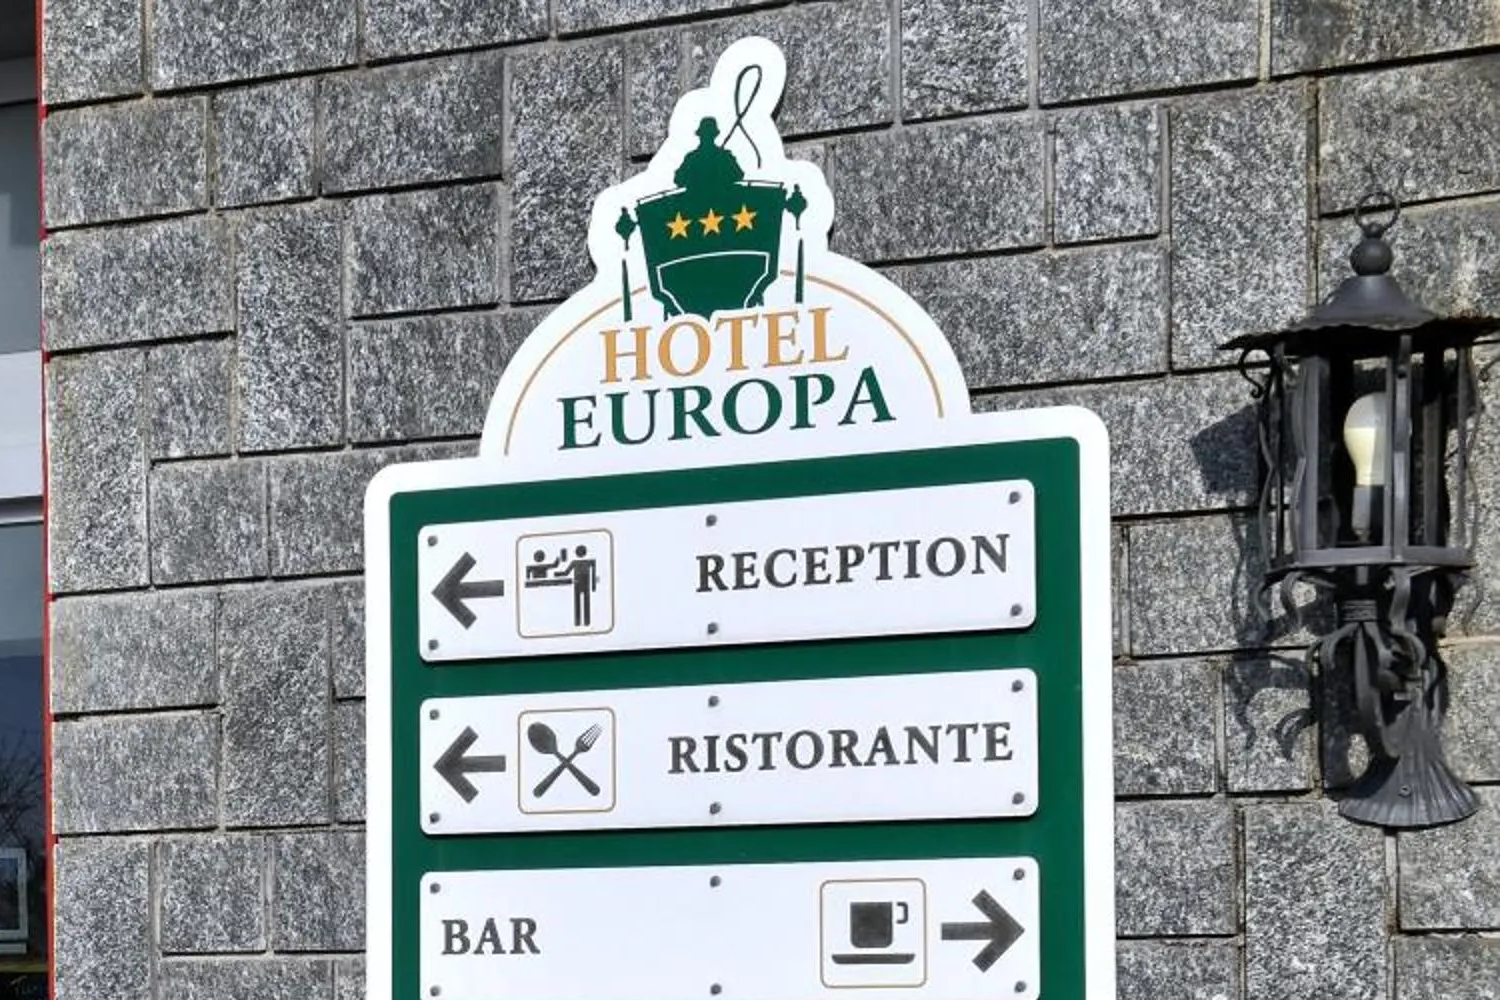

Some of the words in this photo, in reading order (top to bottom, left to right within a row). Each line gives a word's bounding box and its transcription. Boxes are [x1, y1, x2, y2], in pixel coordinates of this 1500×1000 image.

[600, 307, 849, 384] HOTEL
[557, 366, 896, 451] EUROPA
[695, 533, 1010, 593] RECEPTION
[667, 722, 1013, 774] RISTORANTE
[442, 917, 541, 955] BAR
